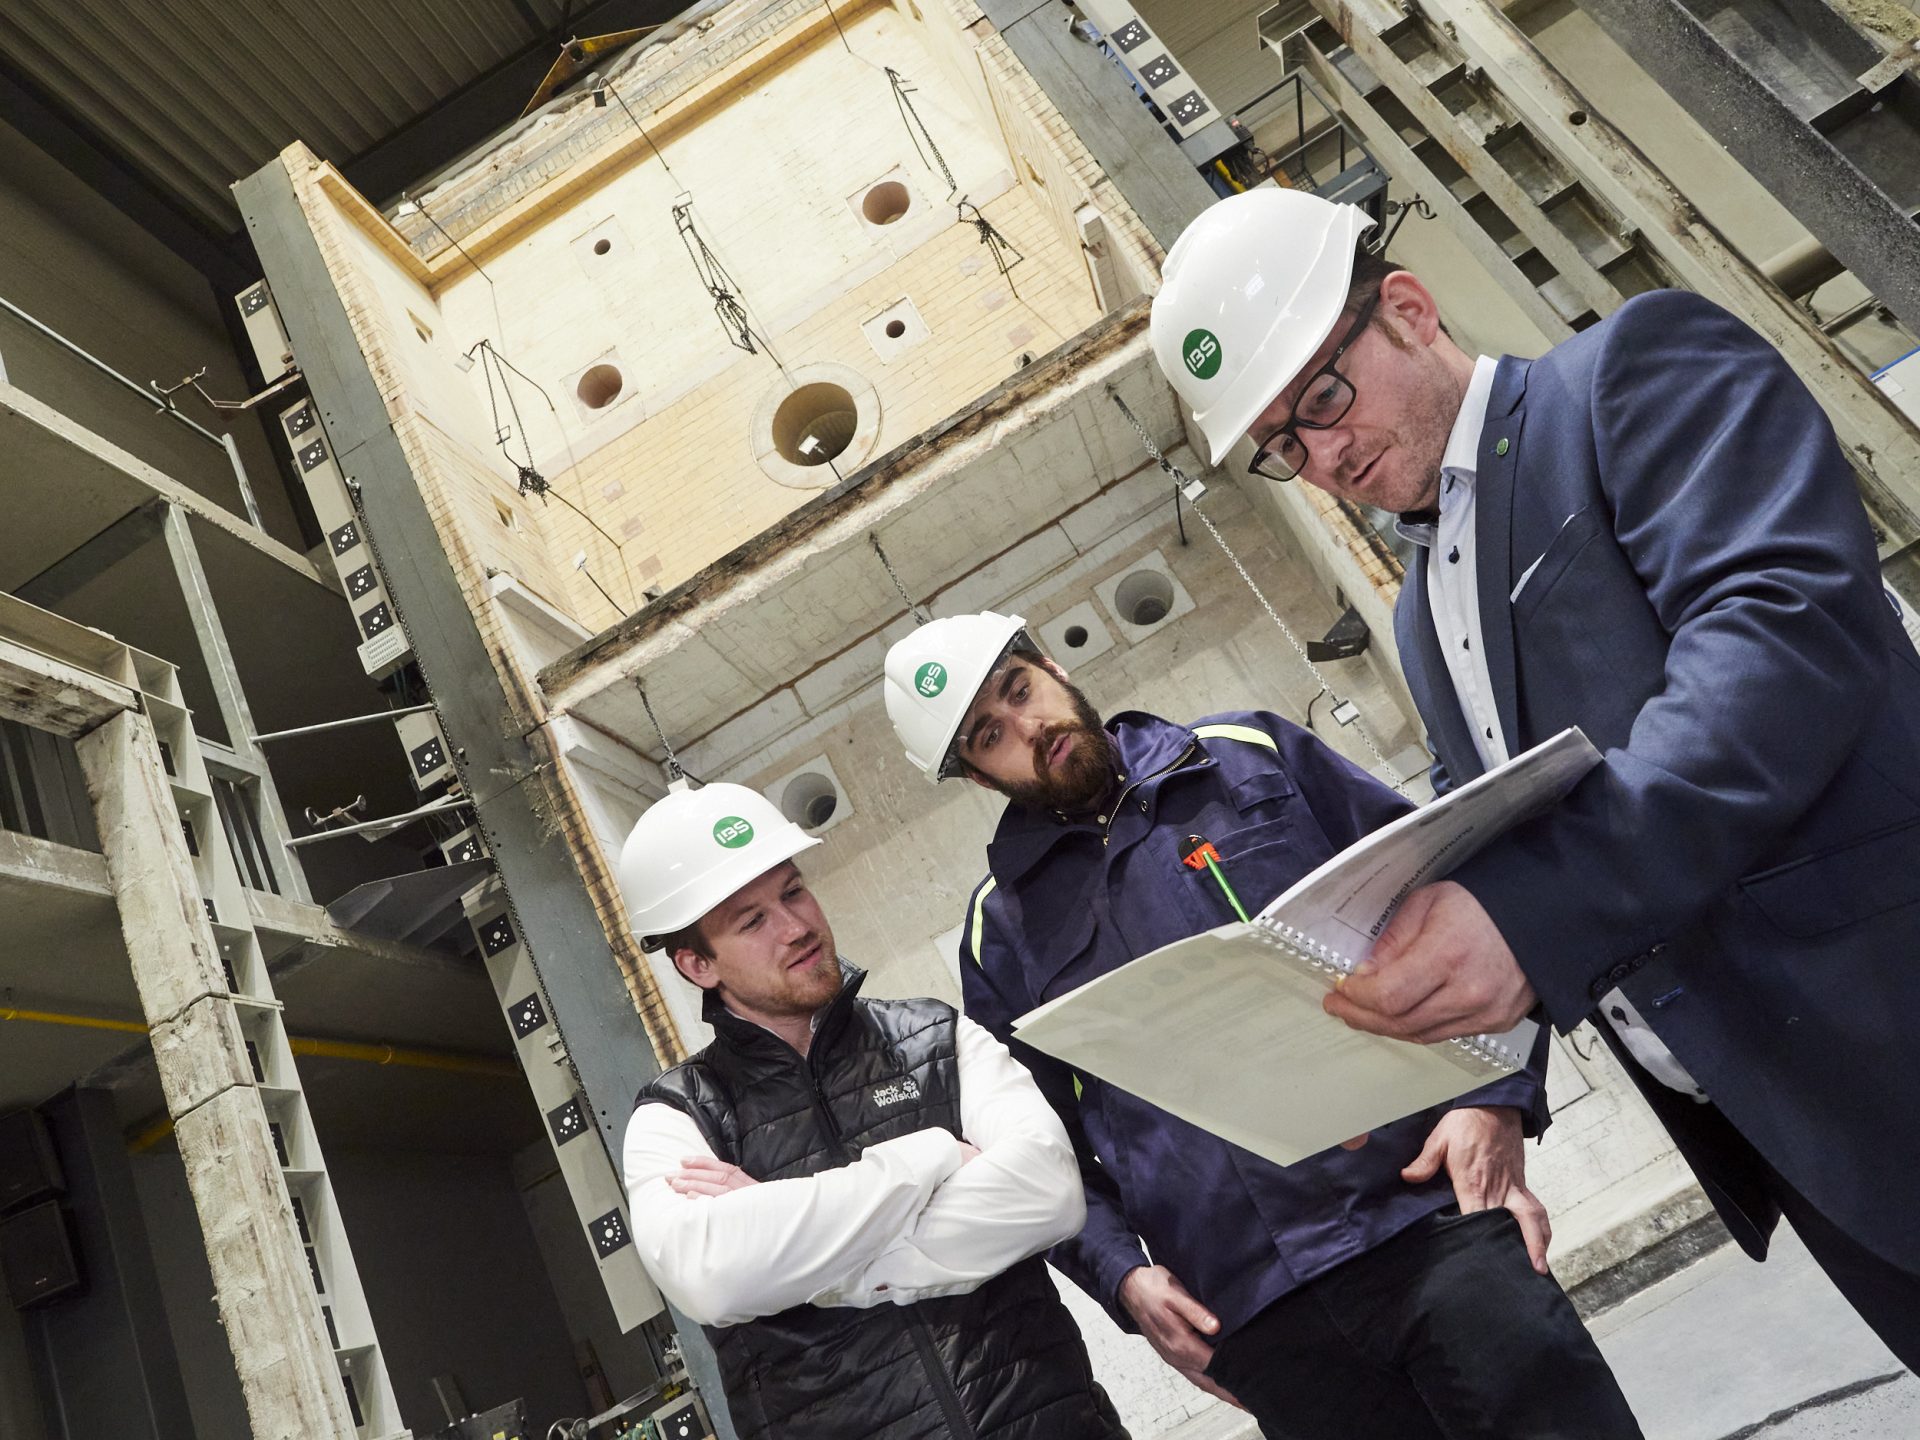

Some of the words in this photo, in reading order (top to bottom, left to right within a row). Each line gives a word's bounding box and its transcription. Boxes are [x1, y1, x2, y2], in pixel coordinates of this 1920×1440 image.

[1186, 335, 1217, 373] IBS
[716, 820, 750, 844] IBS
[873, 1085, 900, 1099] Jack
[874, 1090, 920, 1108] Wolfskin
